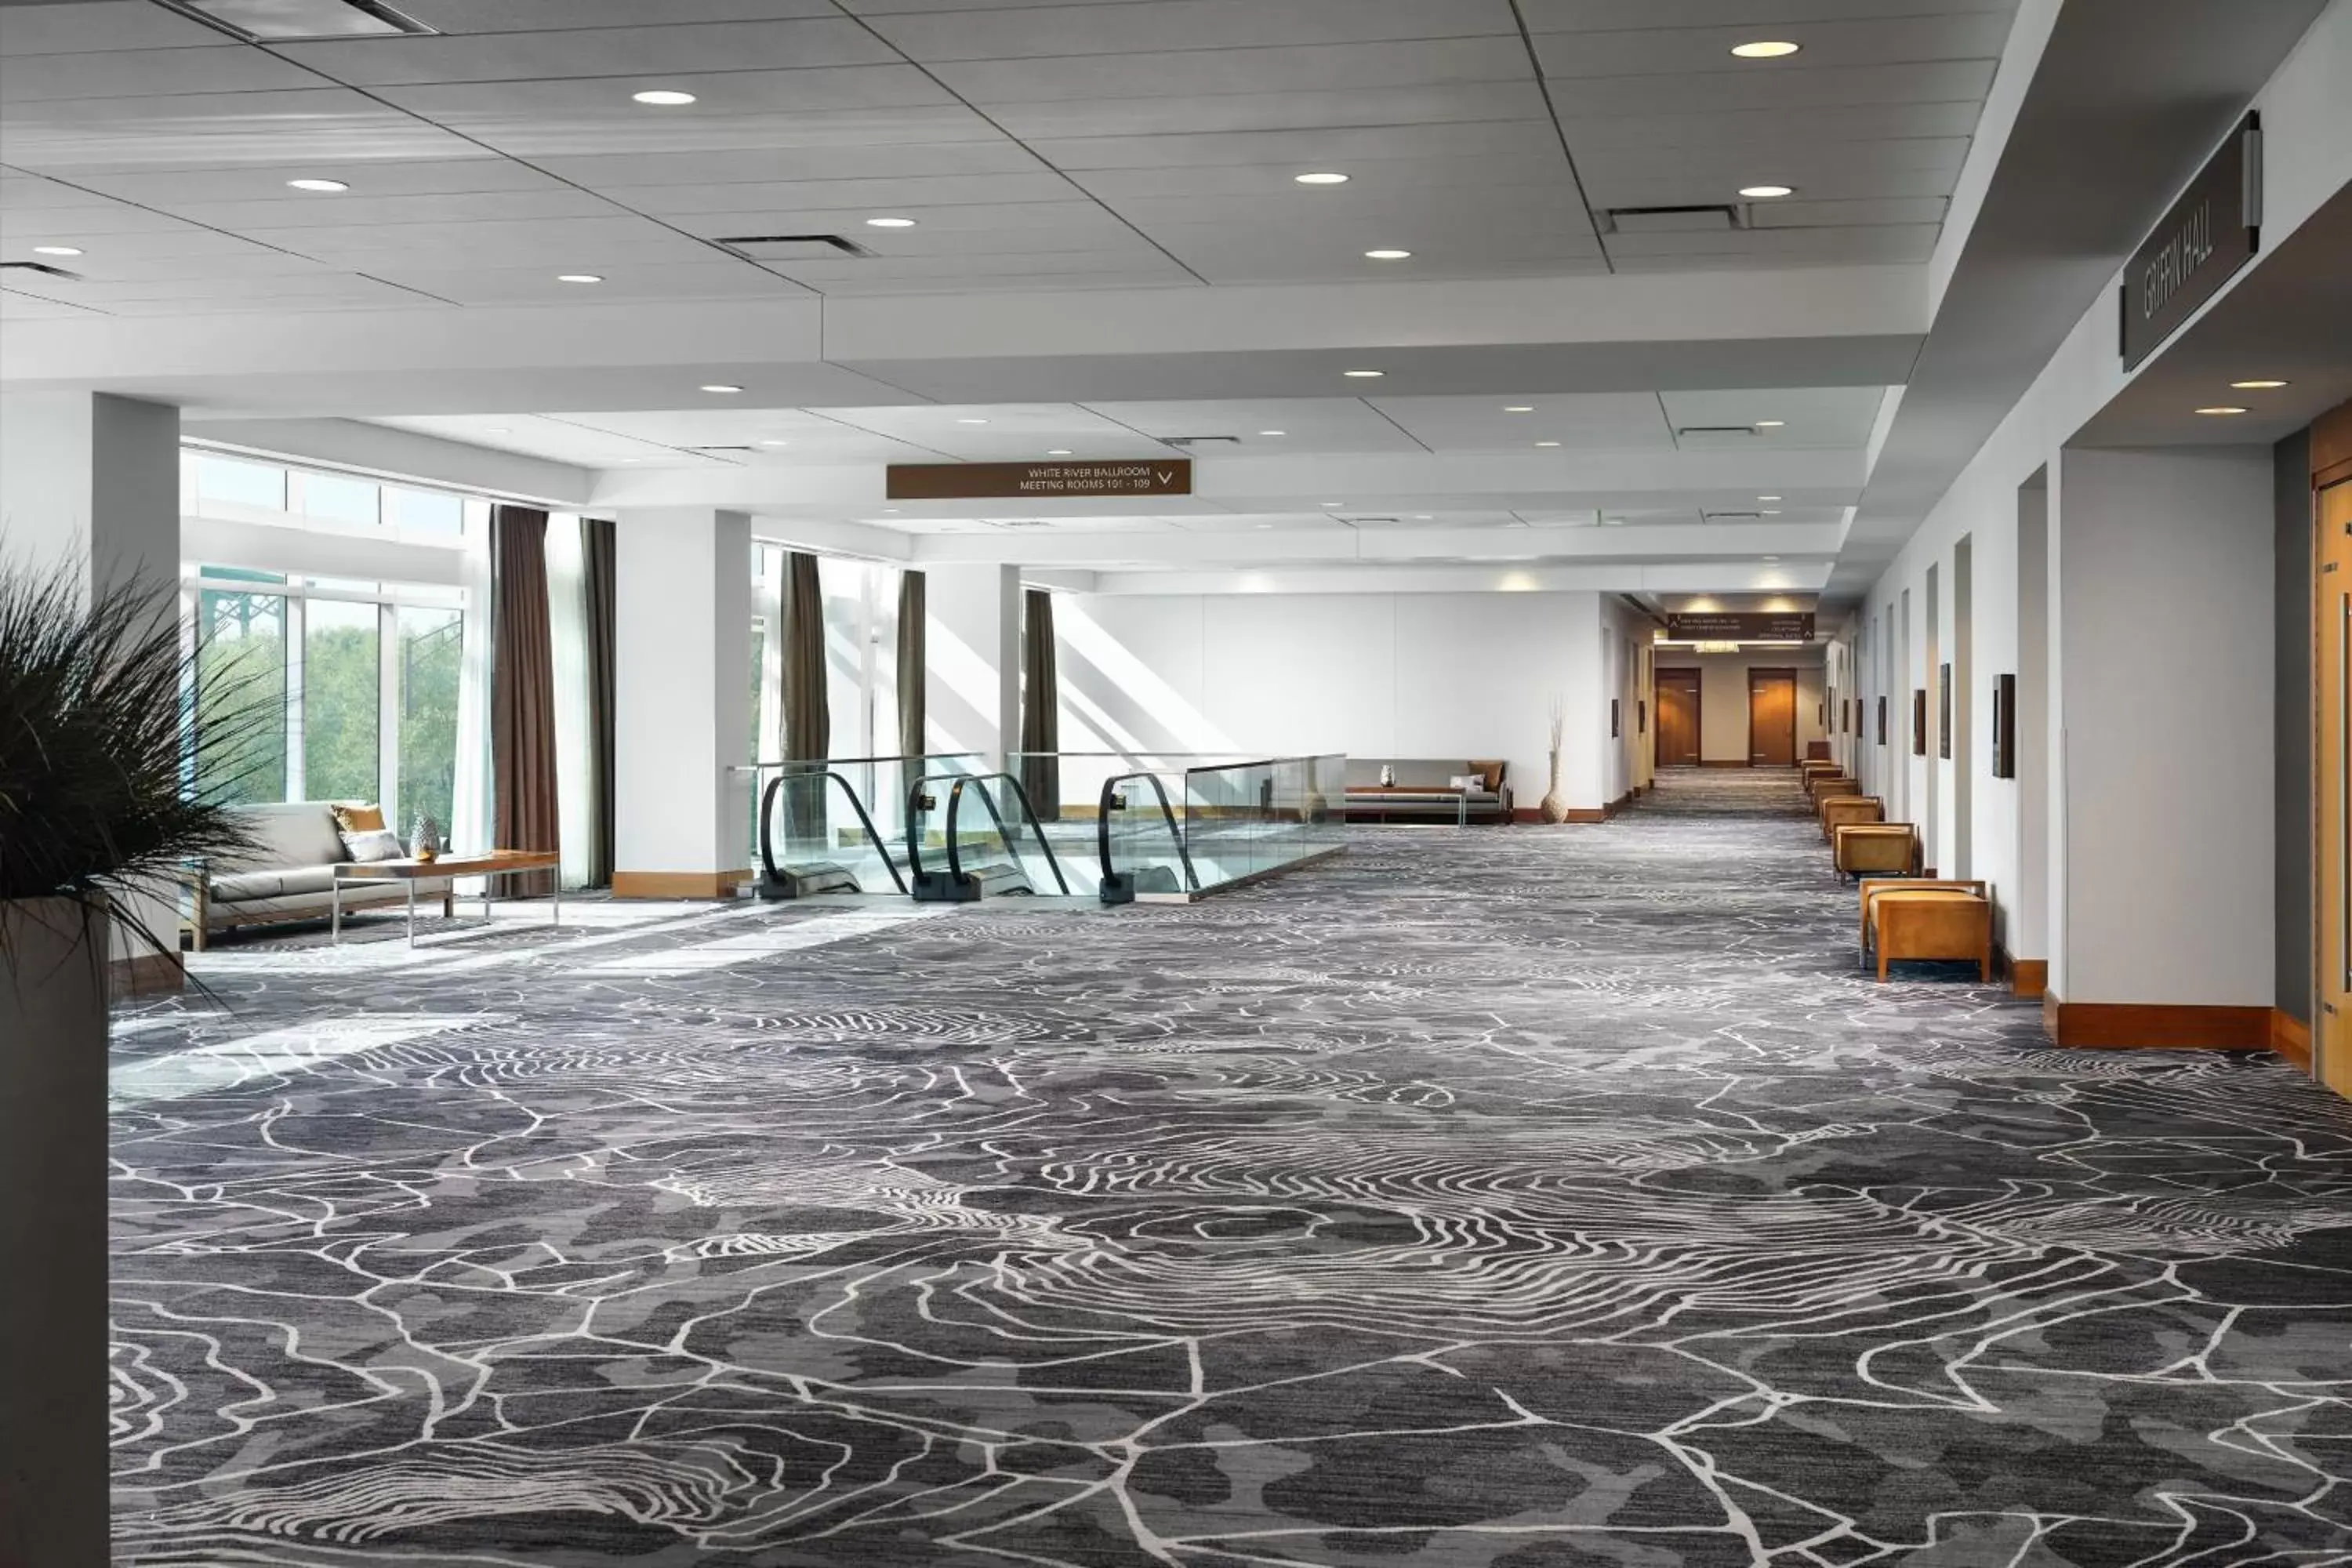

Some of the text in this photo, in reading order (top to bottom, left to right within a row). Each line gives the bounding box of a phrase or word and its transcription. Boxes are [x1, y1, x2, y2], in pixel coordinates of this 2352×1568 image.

[2144, 200, 2213, 319] GRIFFIN HALL
[1028, 466, 1150, 477] WHITE RIVER BALLROOM
[1020, 480, 1064, 490] MEETING
[1067, 479, 1105, 489] ROOMS
[1107, 479, 1123, 488] 101
[1134, 479, 1150, 488] 109
